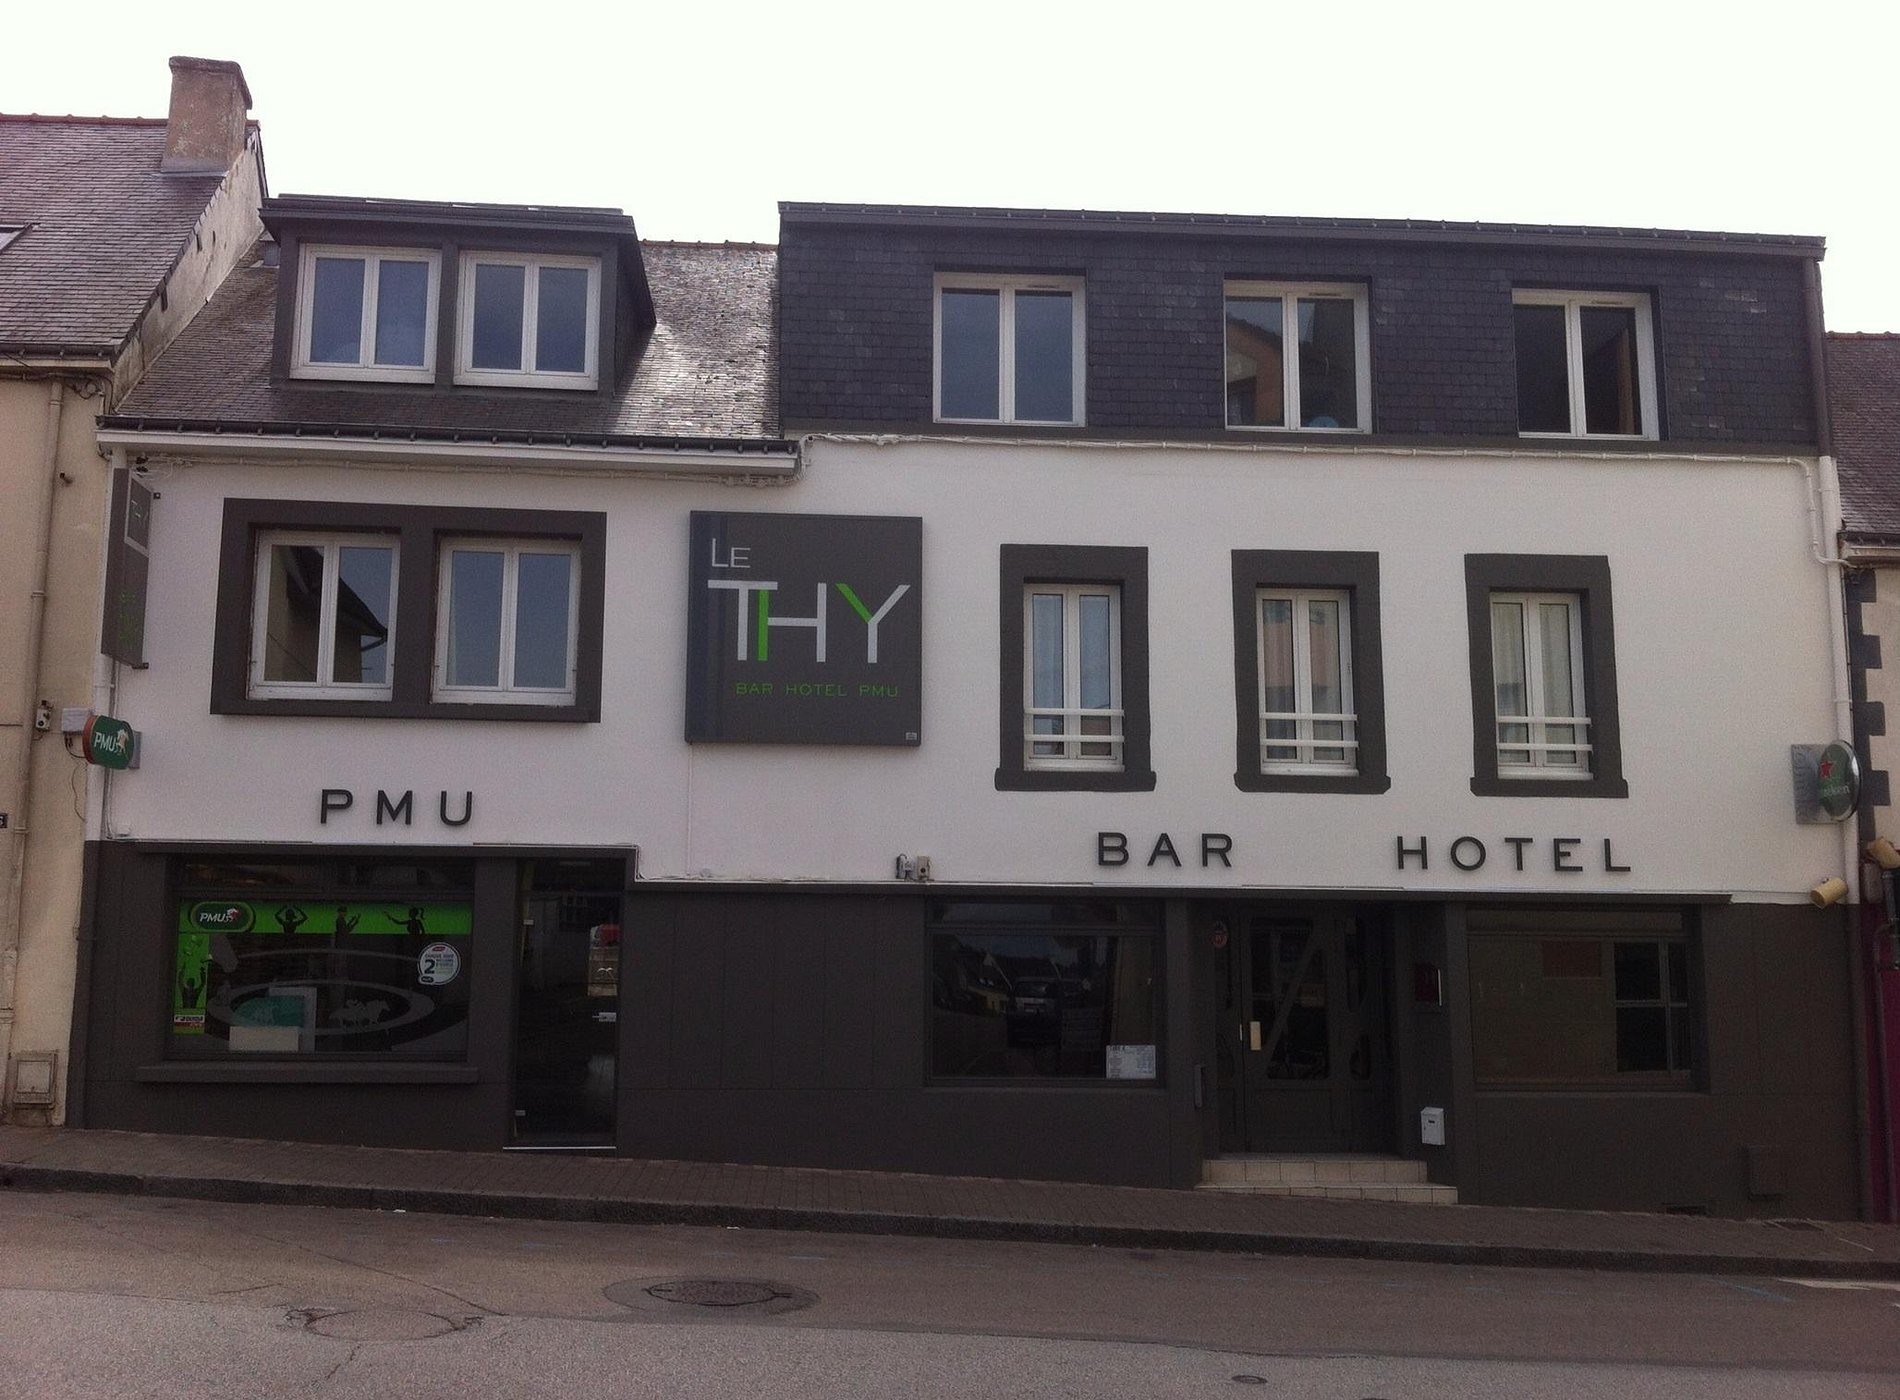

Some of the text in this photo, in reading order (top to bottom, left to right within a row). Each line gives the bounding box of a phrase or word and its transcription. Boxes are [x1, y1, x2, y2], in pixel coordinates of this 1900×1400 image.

[711, 538, 752, 569] LE
[707, 579, 911, 664] THY
[736, 682, 899, 698] BAR HOTEL PMU
[93, 731, 117, 752] PMU
[320, 789, 473, 827] PMU
[1098, 831, 1632, 874] BAR HOTEL
[199, 912, 226, 923] PMU
[424, 959, 436, 974] 2
